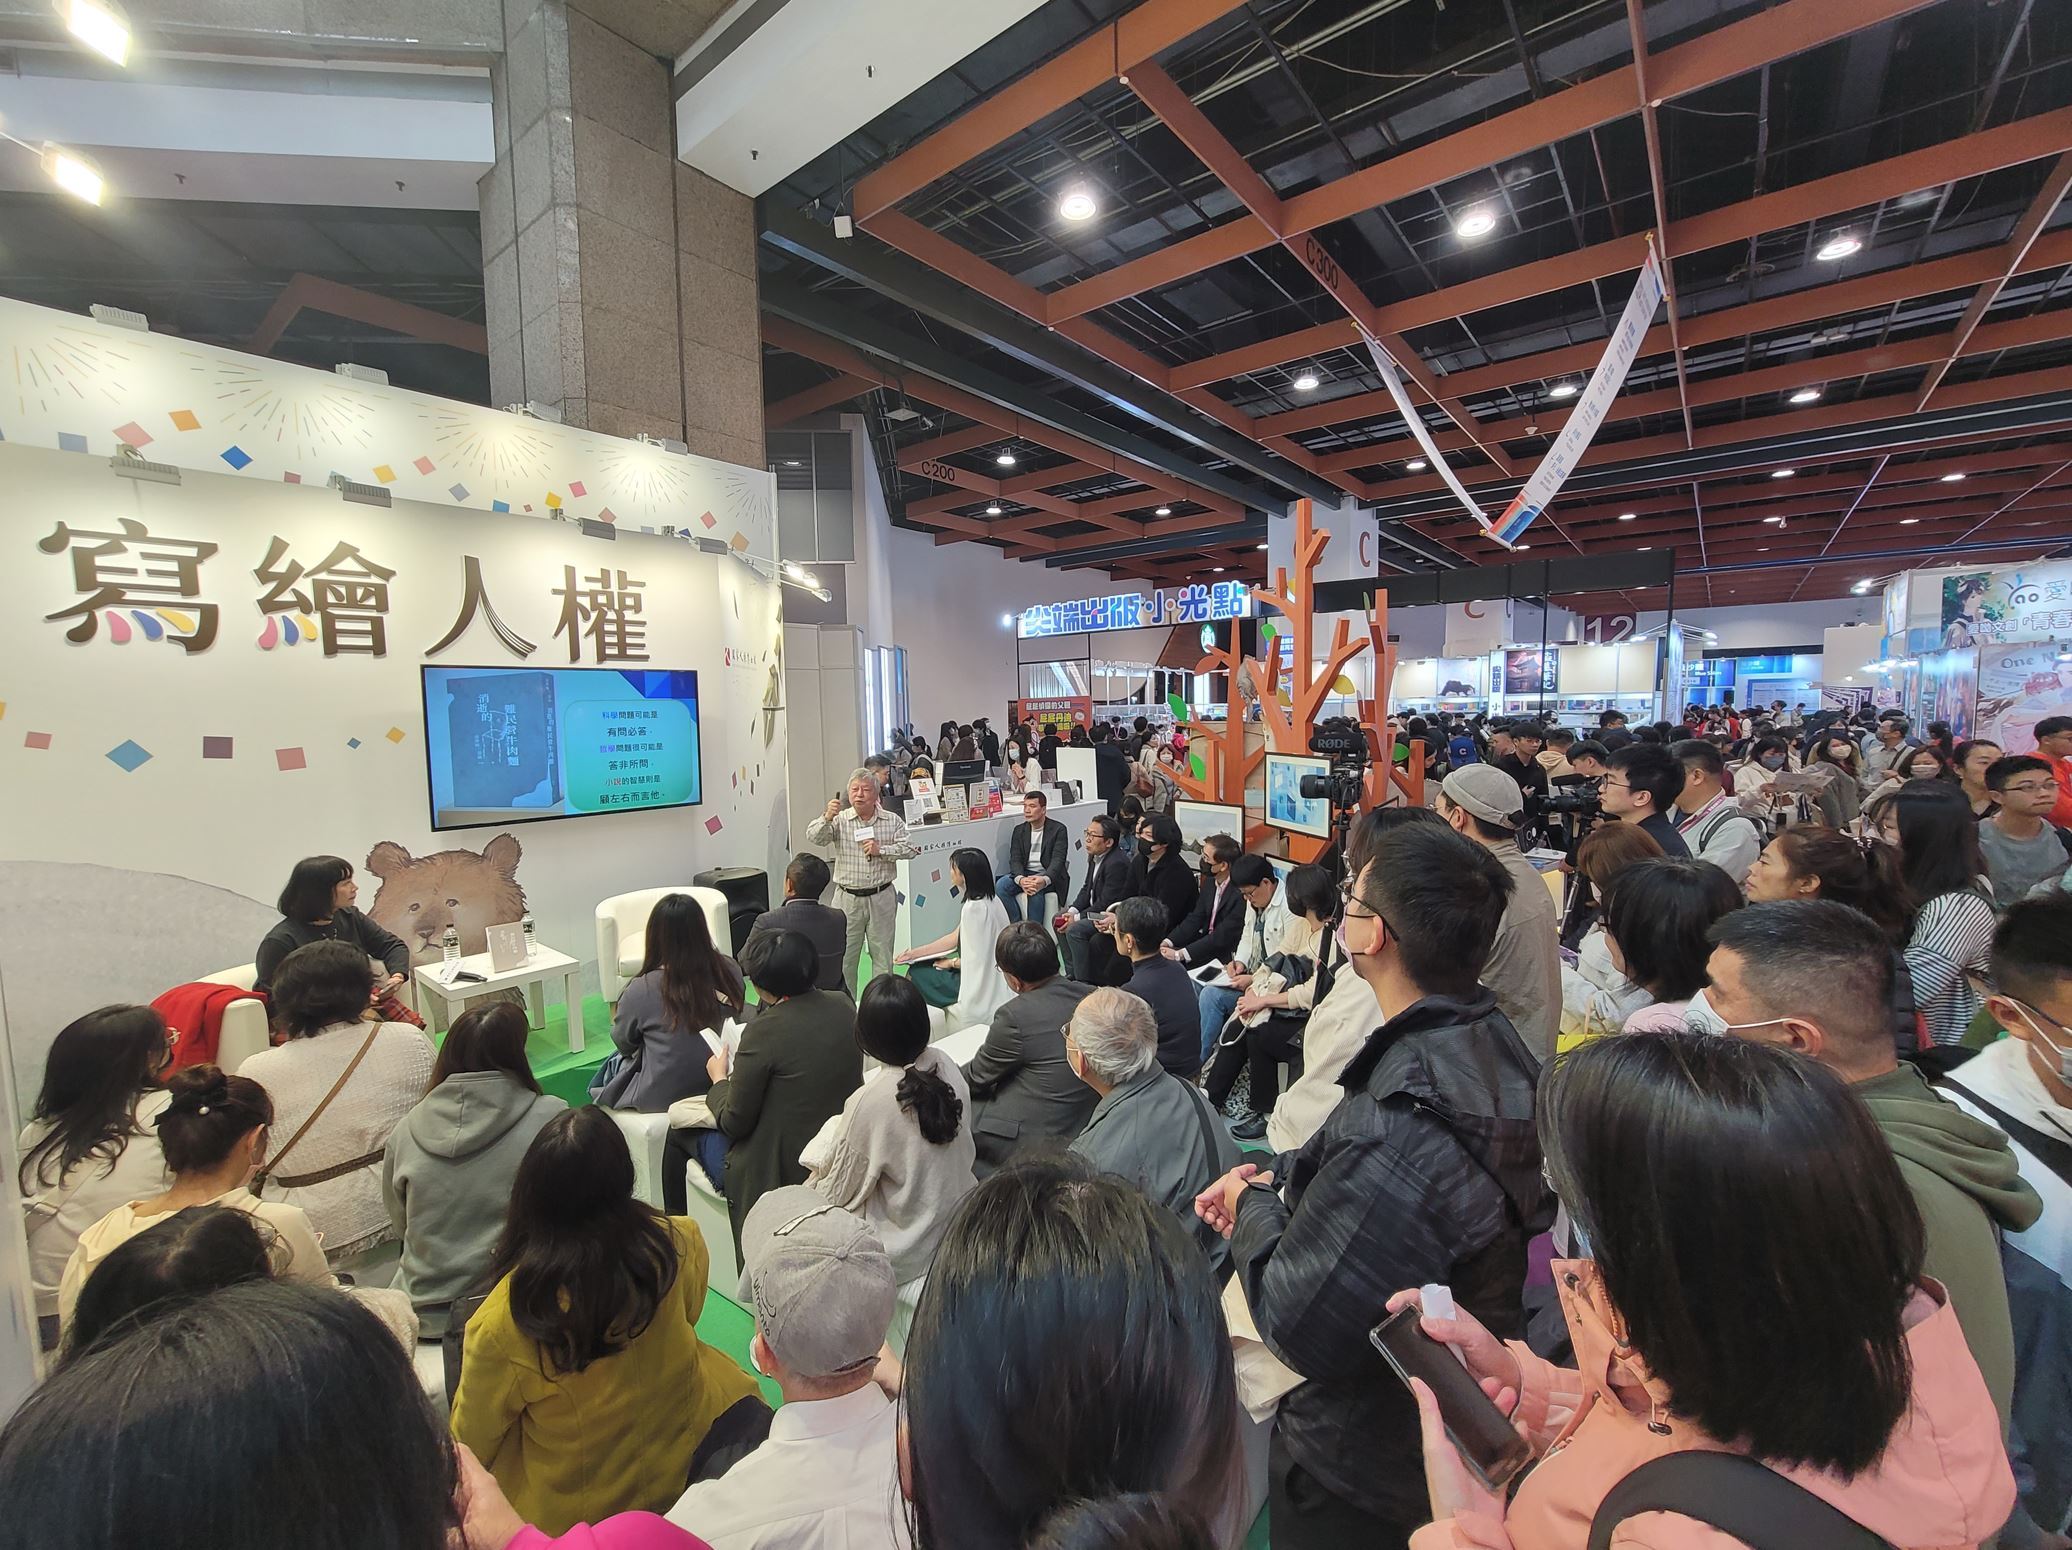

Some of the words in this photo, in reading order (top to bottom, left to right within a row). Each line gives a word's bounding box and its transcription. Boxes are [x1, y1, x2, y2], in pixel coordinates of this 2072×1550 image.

[1359, 531, 1370, 567] C
[38, 517, 650, 664] 寫繪人權
[2044, 580, 2072, 602] 愛
[1586, 616, 1634, 647] 12
[1317, 738, 1351, 749] RØDE
